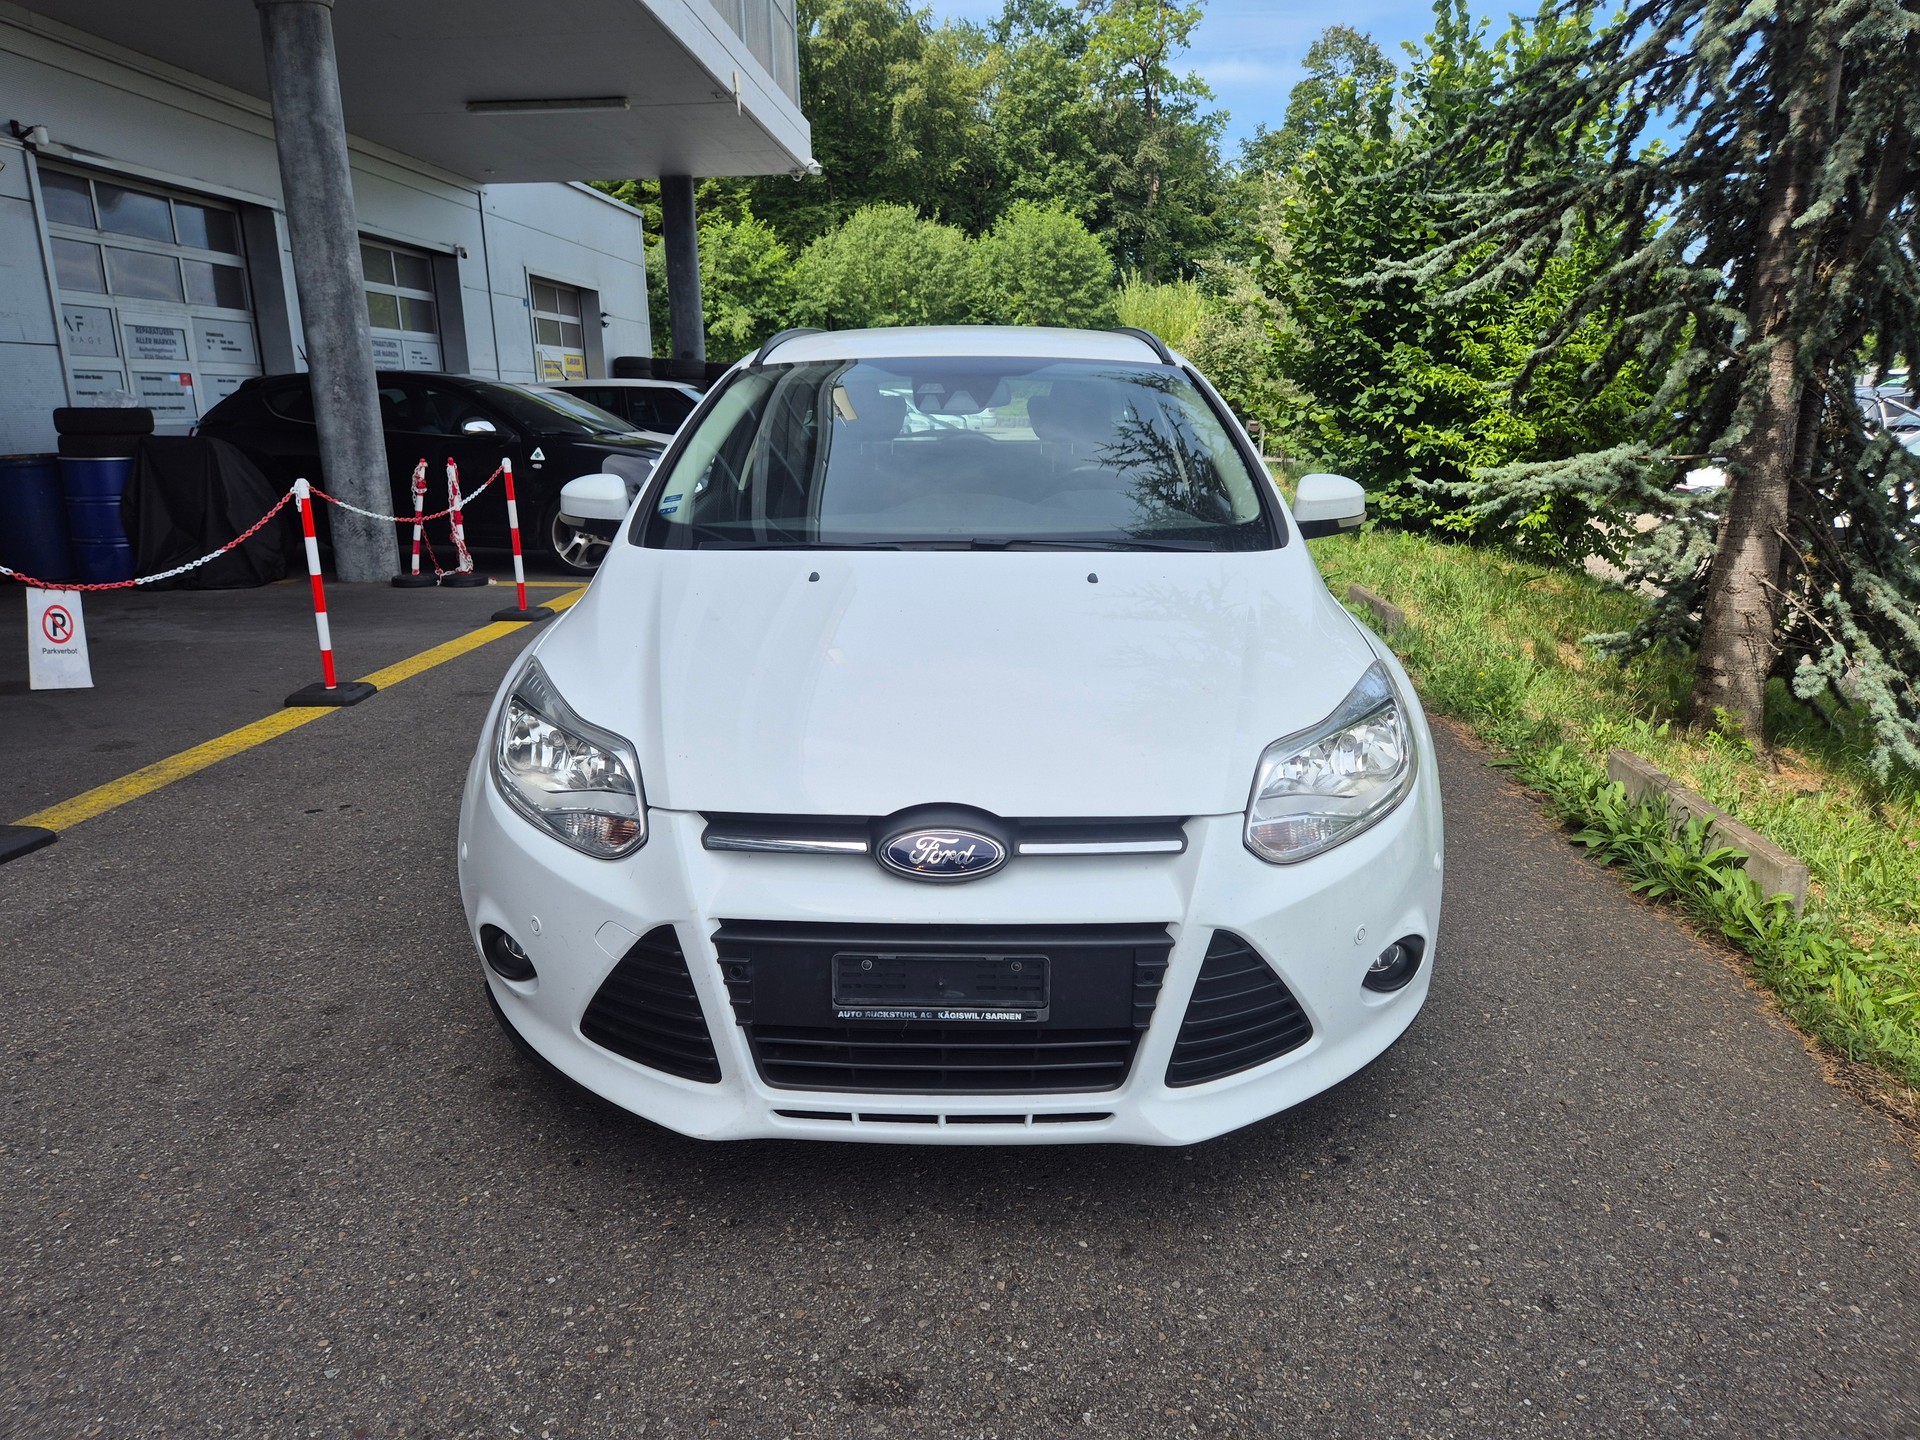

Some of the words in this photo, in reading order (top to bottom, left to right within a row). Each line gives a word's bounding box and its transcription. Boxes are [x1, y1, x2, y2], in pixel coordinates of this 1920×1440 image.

[42, 647, 78, 655] Parkverbot
[909, 836, 977, 865] Ford
[837, 1010, 863, 1019] AUTO
